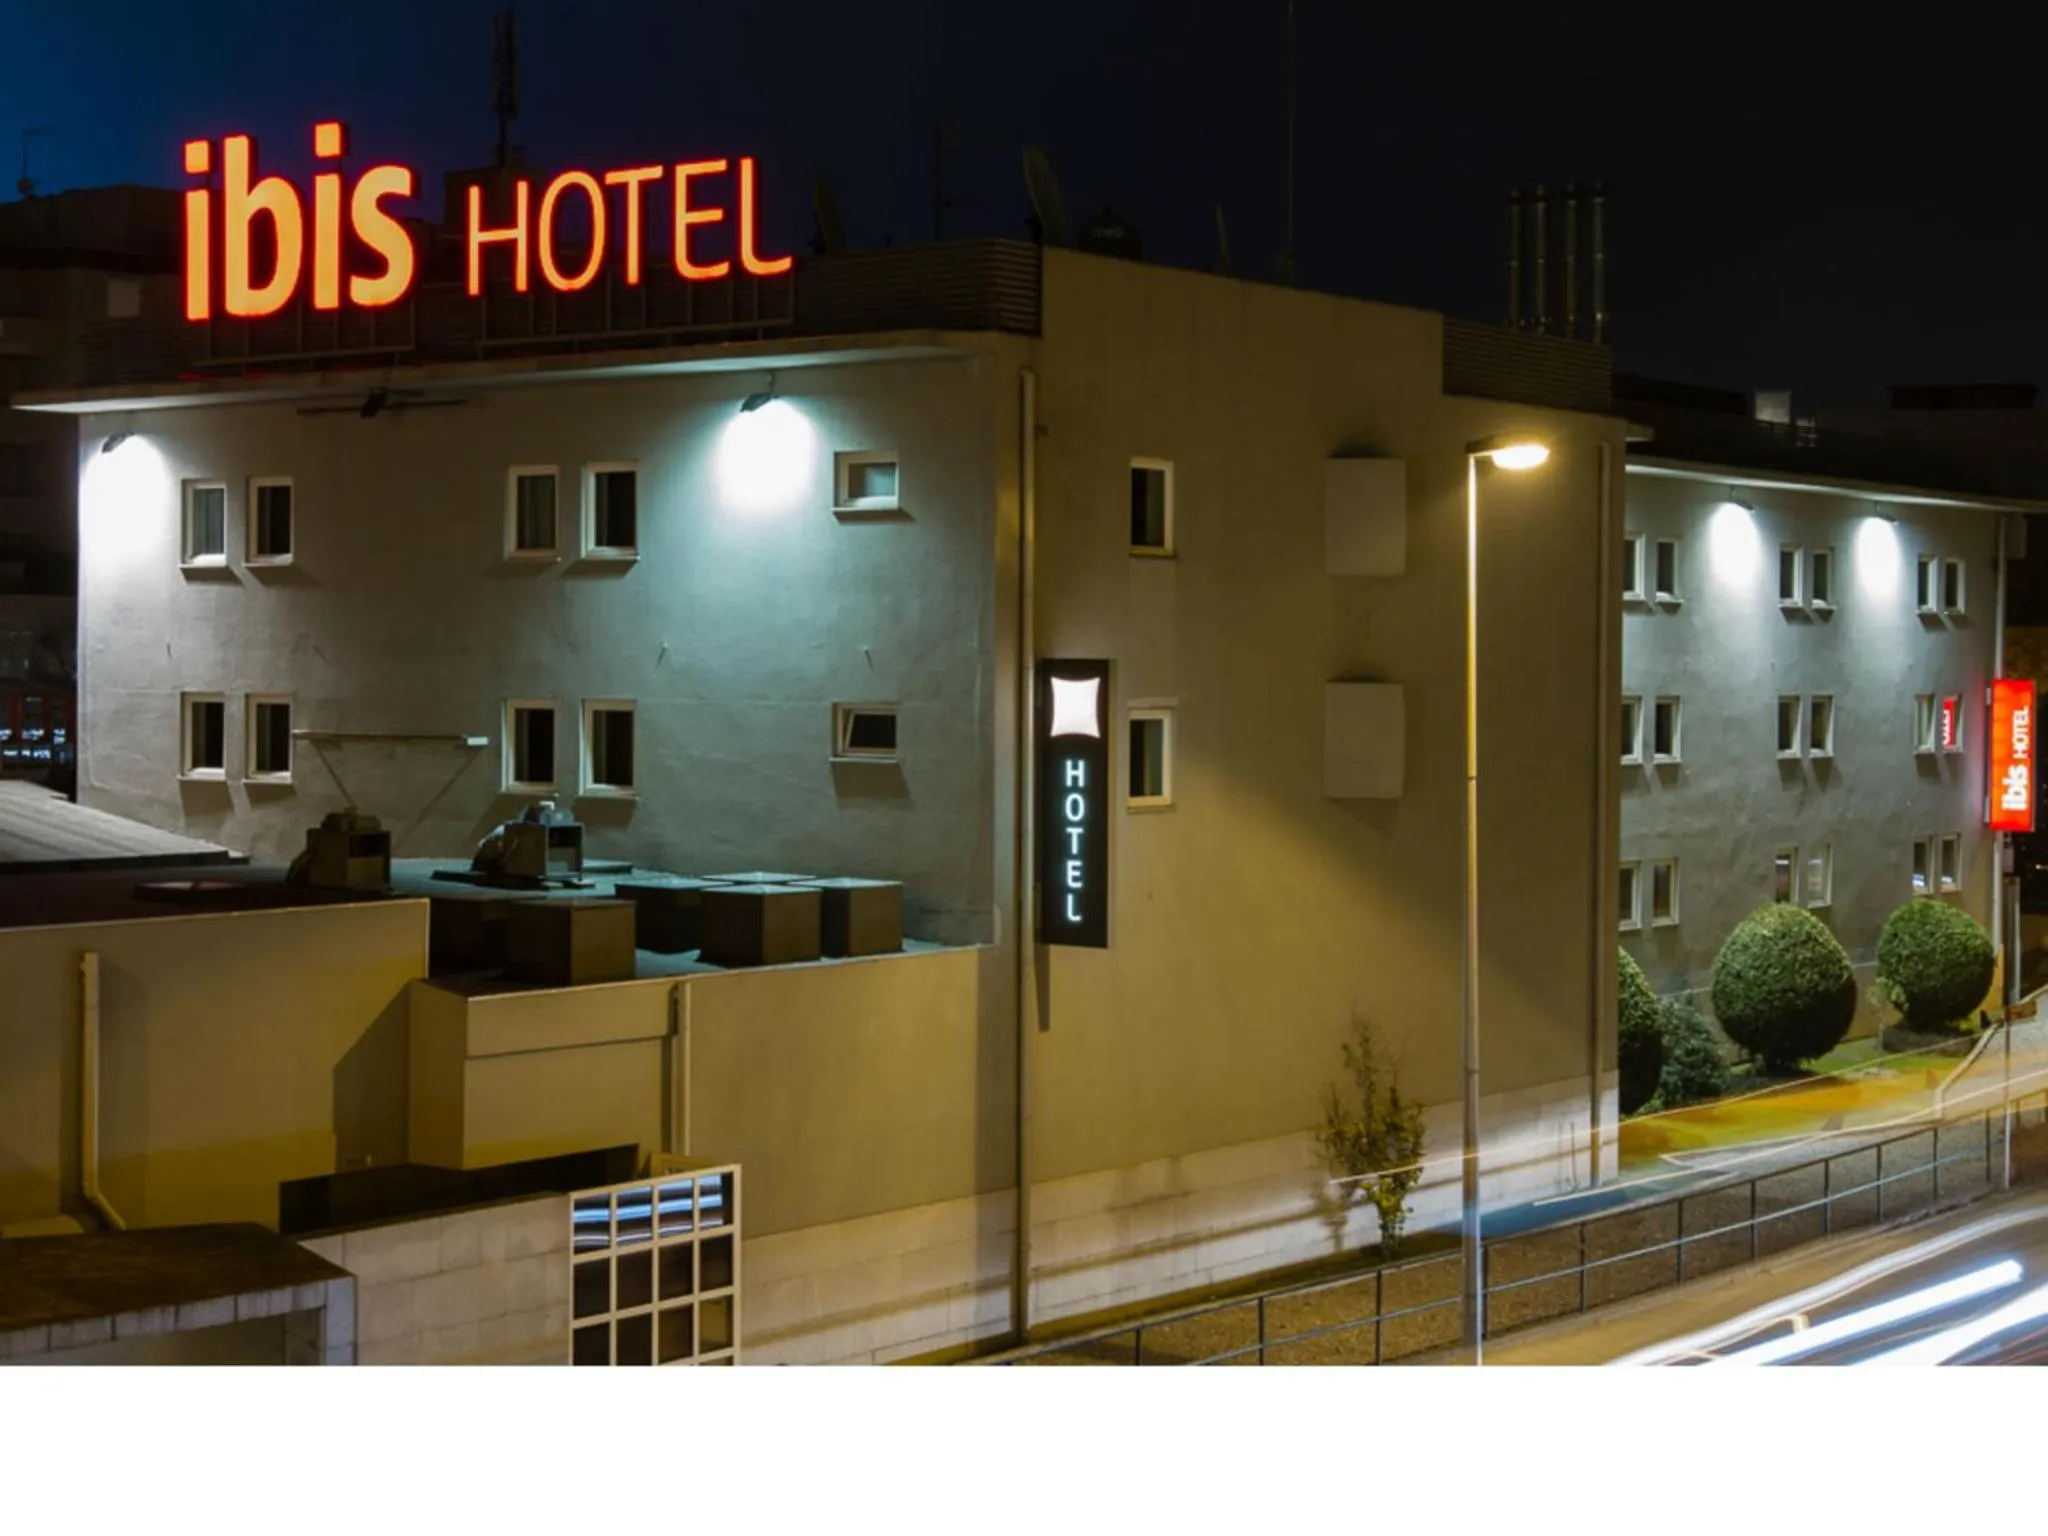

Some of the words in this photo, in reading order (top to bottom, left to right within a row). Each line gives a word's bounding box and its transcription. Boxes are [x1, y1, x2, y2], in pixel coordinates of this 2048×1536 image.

[184, 121, 415, 321] ibis
[467, 156, 793, 296] HOTEL
[2001, 764, 2028, 811] ibis
[2012, 706, 2029, 760] HOTEL
[1064, 758, 1086, 922] HOTEL
